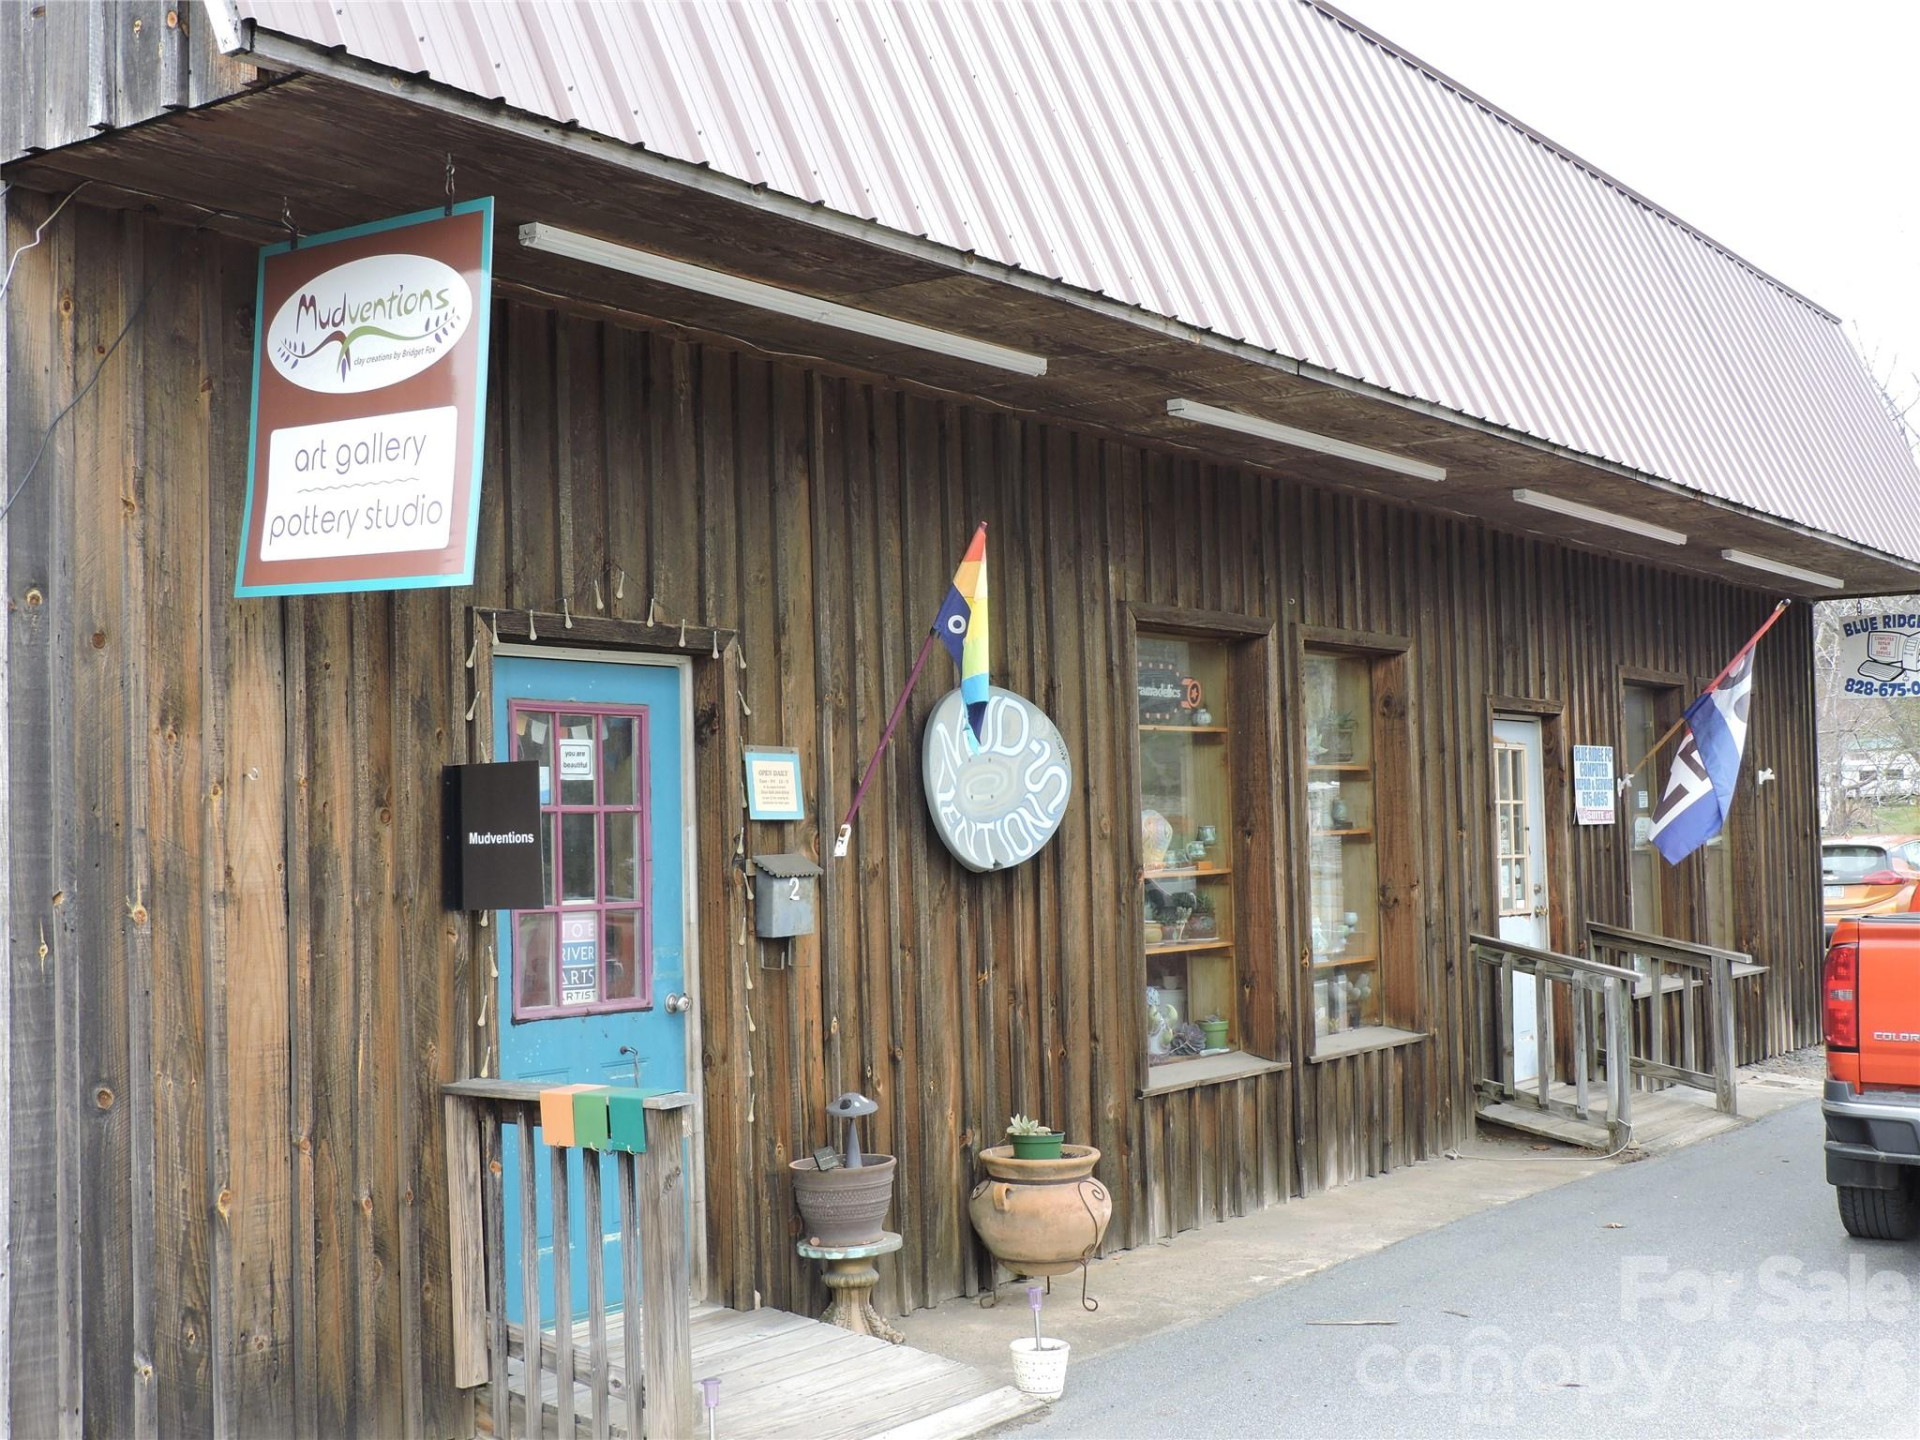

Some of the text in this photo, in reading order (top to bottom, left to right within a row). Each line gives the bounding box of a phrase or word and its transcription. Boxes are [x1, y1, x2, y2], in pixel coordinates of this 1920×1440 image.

[296, 285, 449, 334] Mudventions
[354, 347, 436, 367] clay creations by Bridget Fox
[295, 433, 427, 475] art gallery
[269, 494, 443, 545] pottery studio
[1843, 616, 1879, 637] BLUE
[1580, 762, 1608, 777] COMPUTER
[468, 831, 535, 845] Mudventions
[789, 877, 800, 900] 2
